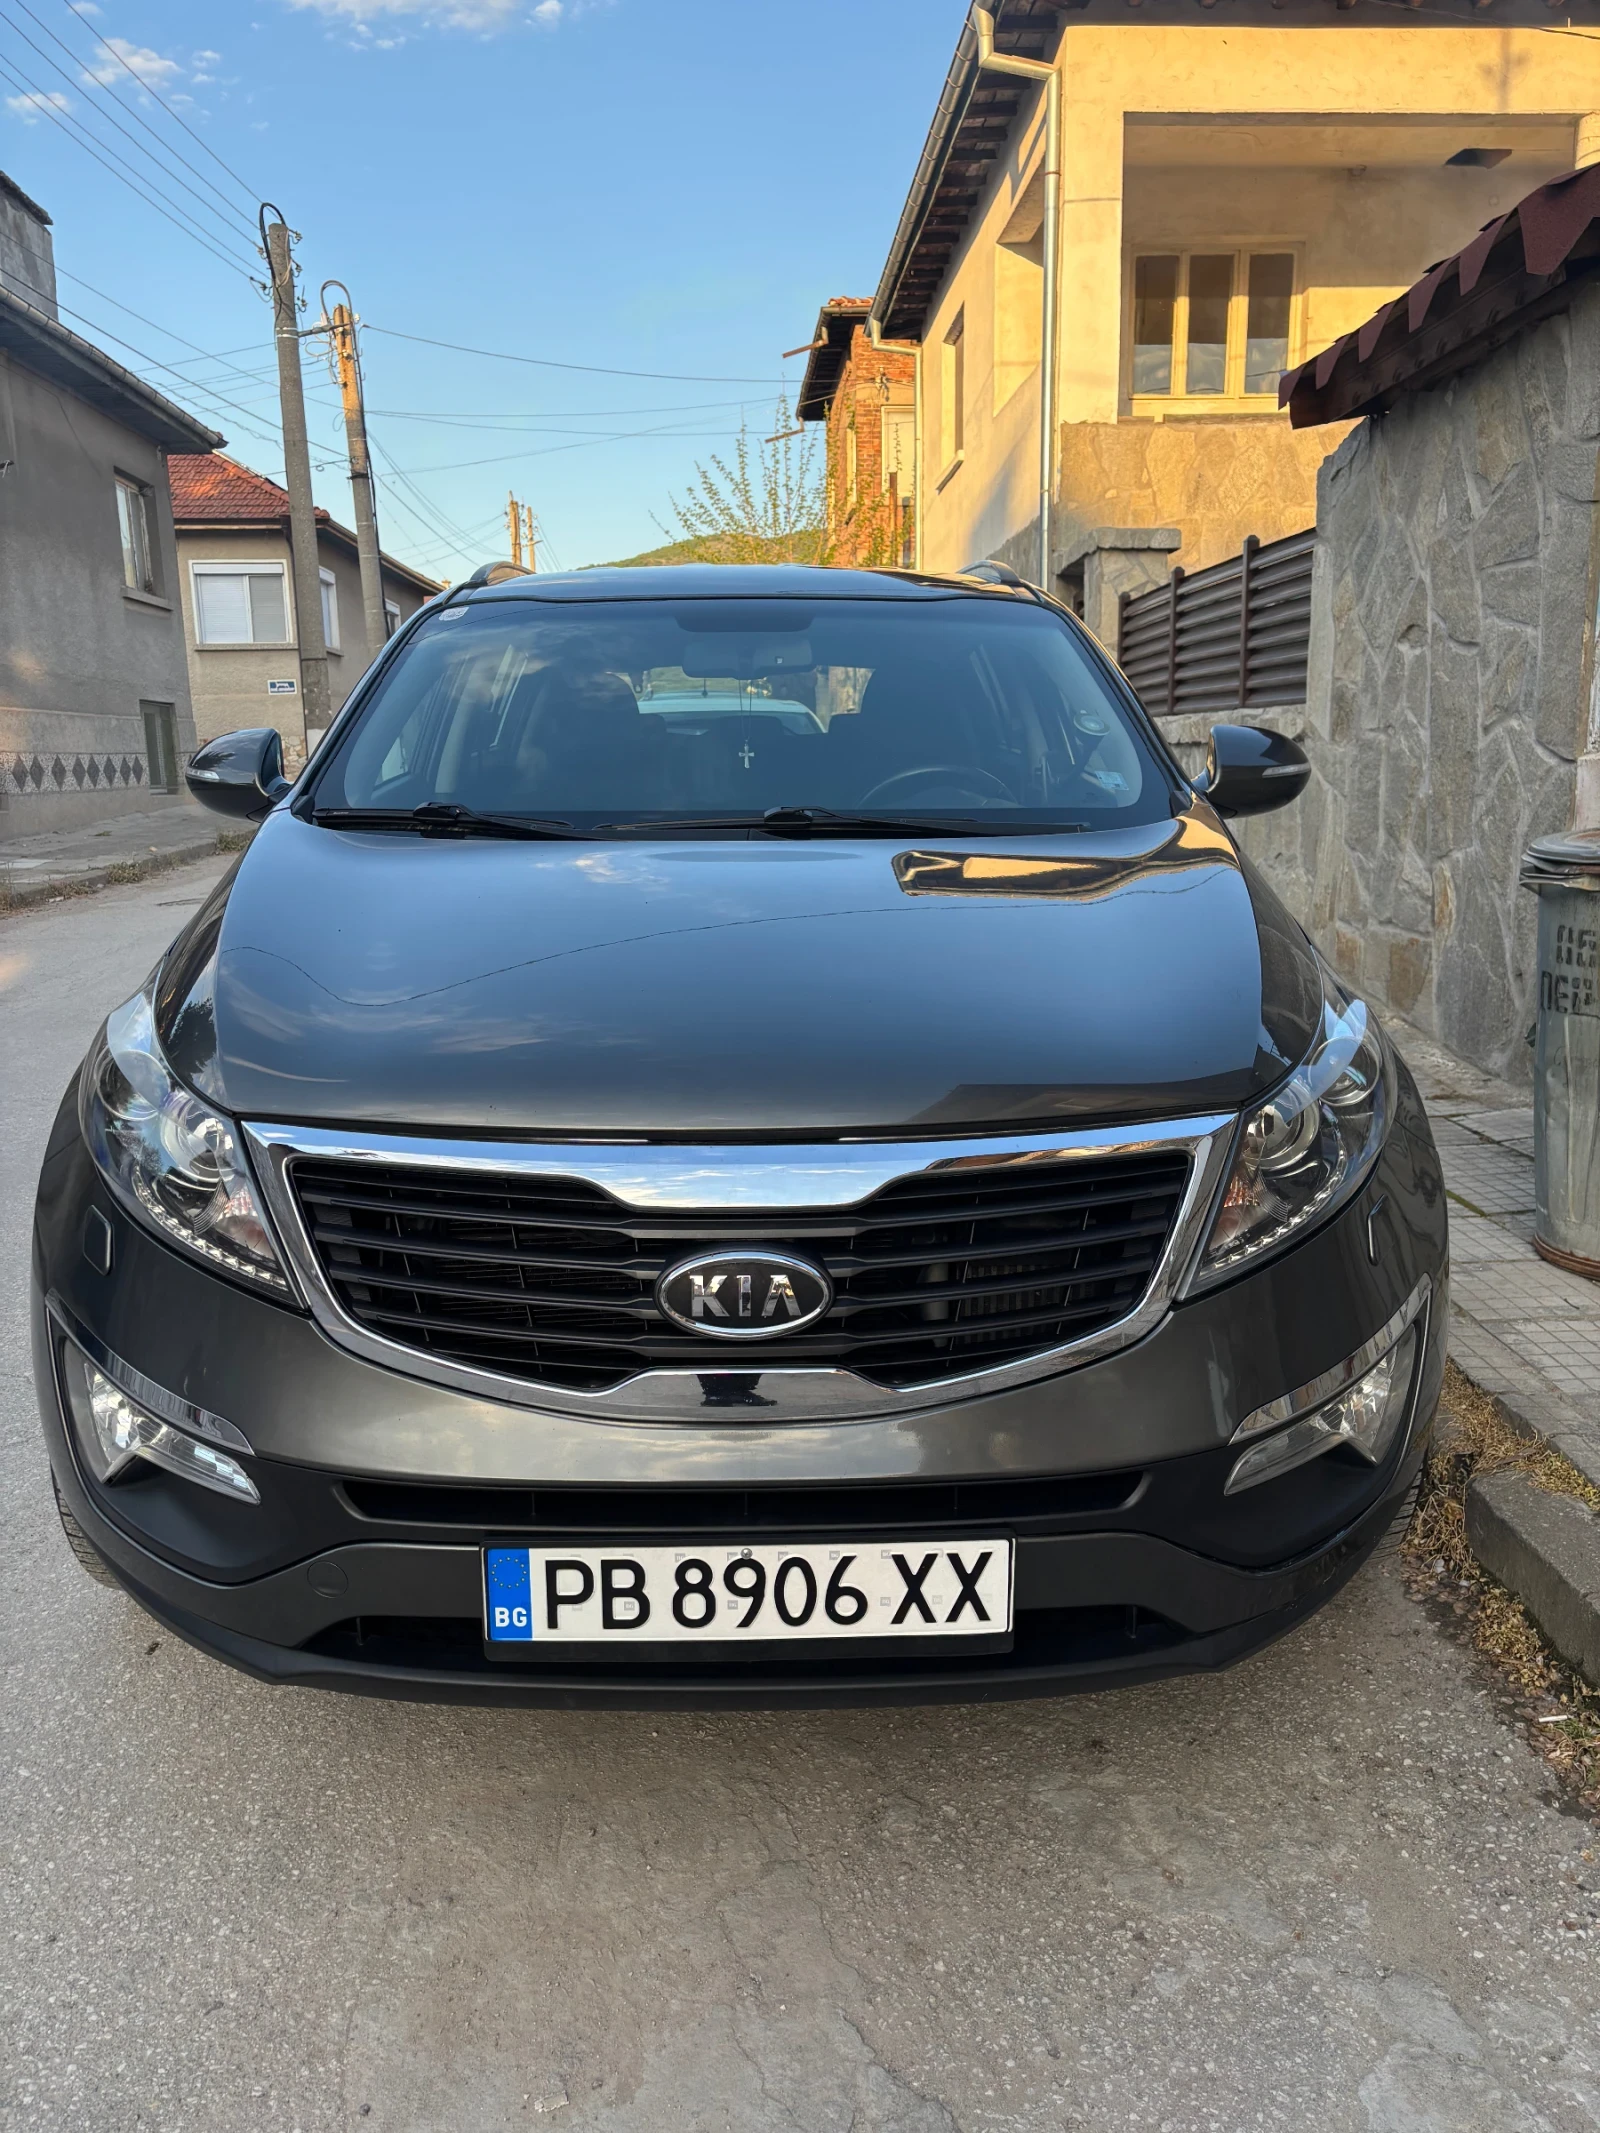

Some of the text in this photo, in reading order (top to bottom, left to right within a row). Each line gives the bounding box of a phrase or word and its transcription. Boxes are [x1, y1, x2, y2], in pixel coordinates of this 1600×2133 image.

[689, 1274, 801, 1317] KIA
[545, 1551, 993, 1629] PB 8906 XX
[494, 1607, 527, 1627] BG
